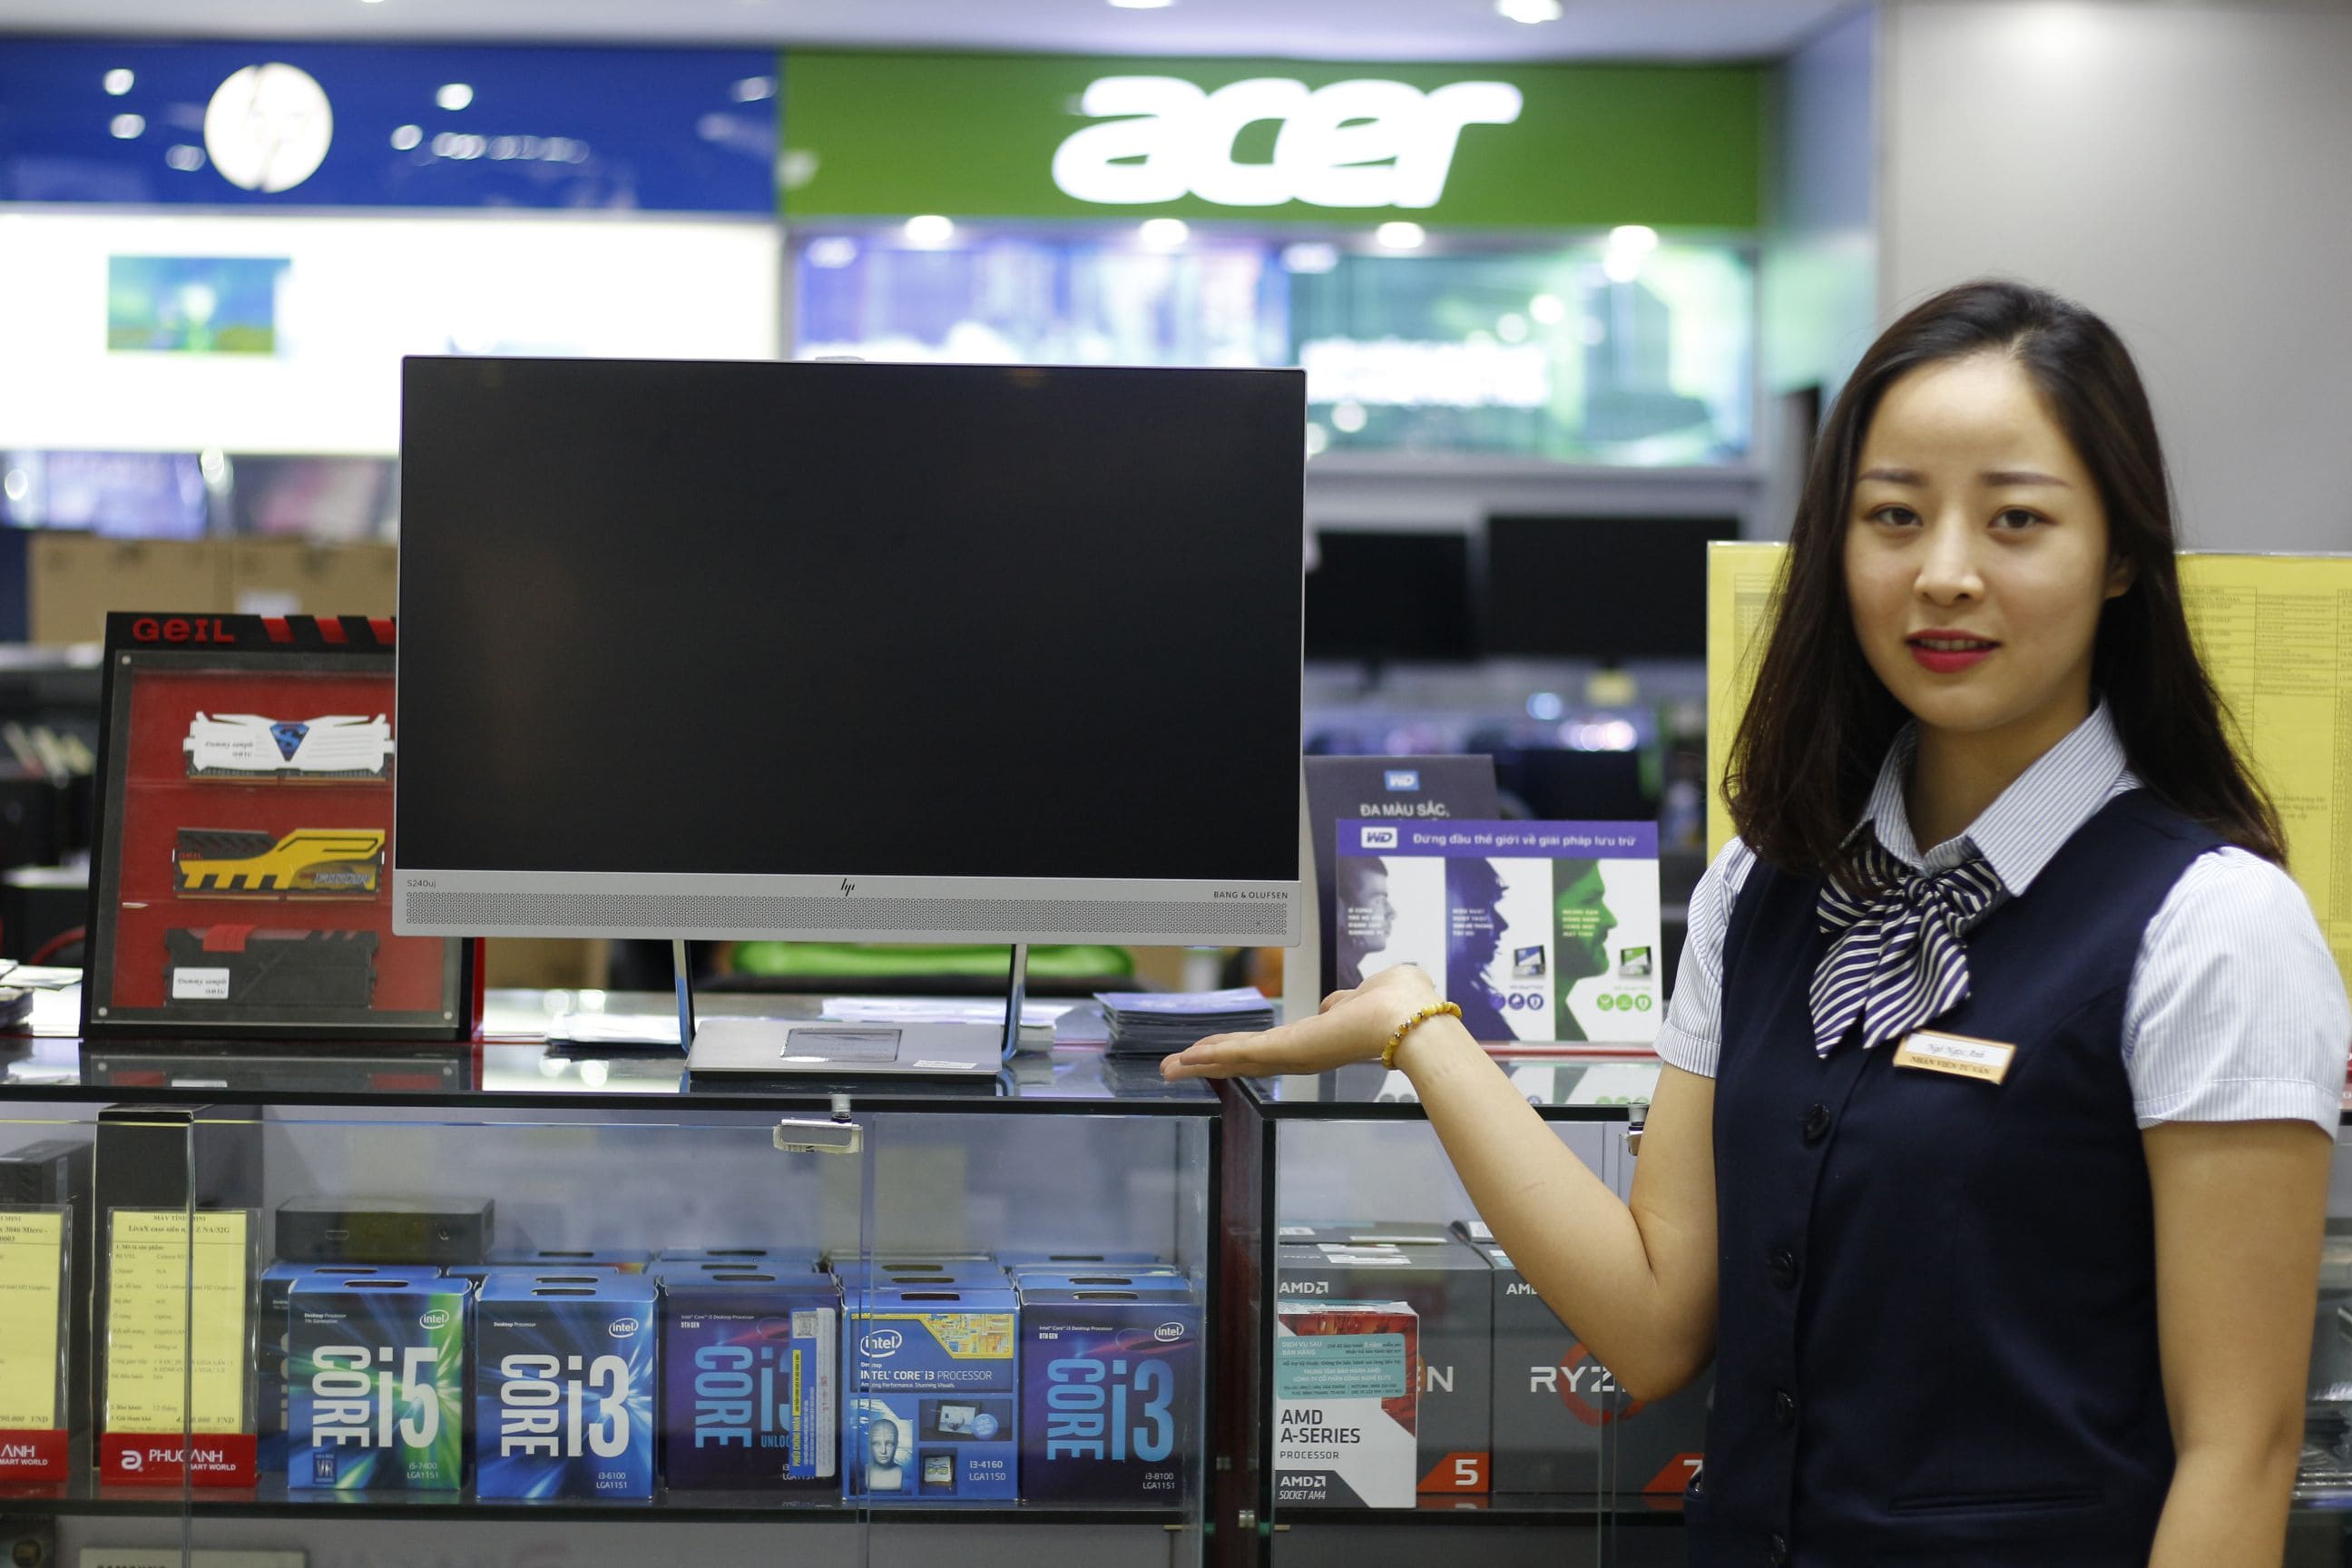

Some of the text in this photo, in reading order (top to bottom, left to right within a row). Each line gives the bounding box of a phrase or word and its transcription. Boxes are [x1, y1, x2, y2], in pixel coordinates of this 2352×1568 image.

[1053, 76, 1522, 207] acer
[1360, 805, 1381, 816] ĐA
[1383, 802, 1414, 816] MÀU
[1365, 831, 1394, 843] WD
[1413, 833, 1636, 848] Đứng đầu thế giới về giải pháp lưu trữ
[1249, 891, 1288, 899] OLUFSEN
[1279, 1282, 1315, 1293] AMD
[423, 1314, 446, 1324] intel
[612, 1321, 634, 1332] intel
[1158, 1327, 1181, 1337] intel
[865, 1335, 897, 1349] intel
[925, 1371, 935, 1380] i3
[937, 1371, 993, 1380] PROCESSOR
[1531, 1367, 1626, 1392] RYZ
[312, 1346, 439, 1448] CORE i5
[694, 1346, 753, 1448] CORE
[501, 1354, 630, 1457] CORE i3
[1047, 1358, 1174, 1462] CORE i3
[1281, 1409, 1322, 1425] AMD
[1280, 1428, 1360, 1444] A-SERIES
[1280, 1451, 1339, 1459] PROCESSOR
[969, 1461, 1003, 1469] i3-4160
[598, 1472, 626, 1480] i3-6100
[969, 1473, 1005, 1481] LGA1150
[1455, 1459, 1479, 1485] 5
[596, 1481, 628, 1489] LGA1151
[1142, 1482, 1175, 1490] LGA1151
[1280, 1476, 1314, 1486] AMD
[1279, 1490, 1326, 1500] SOCKET AM4
